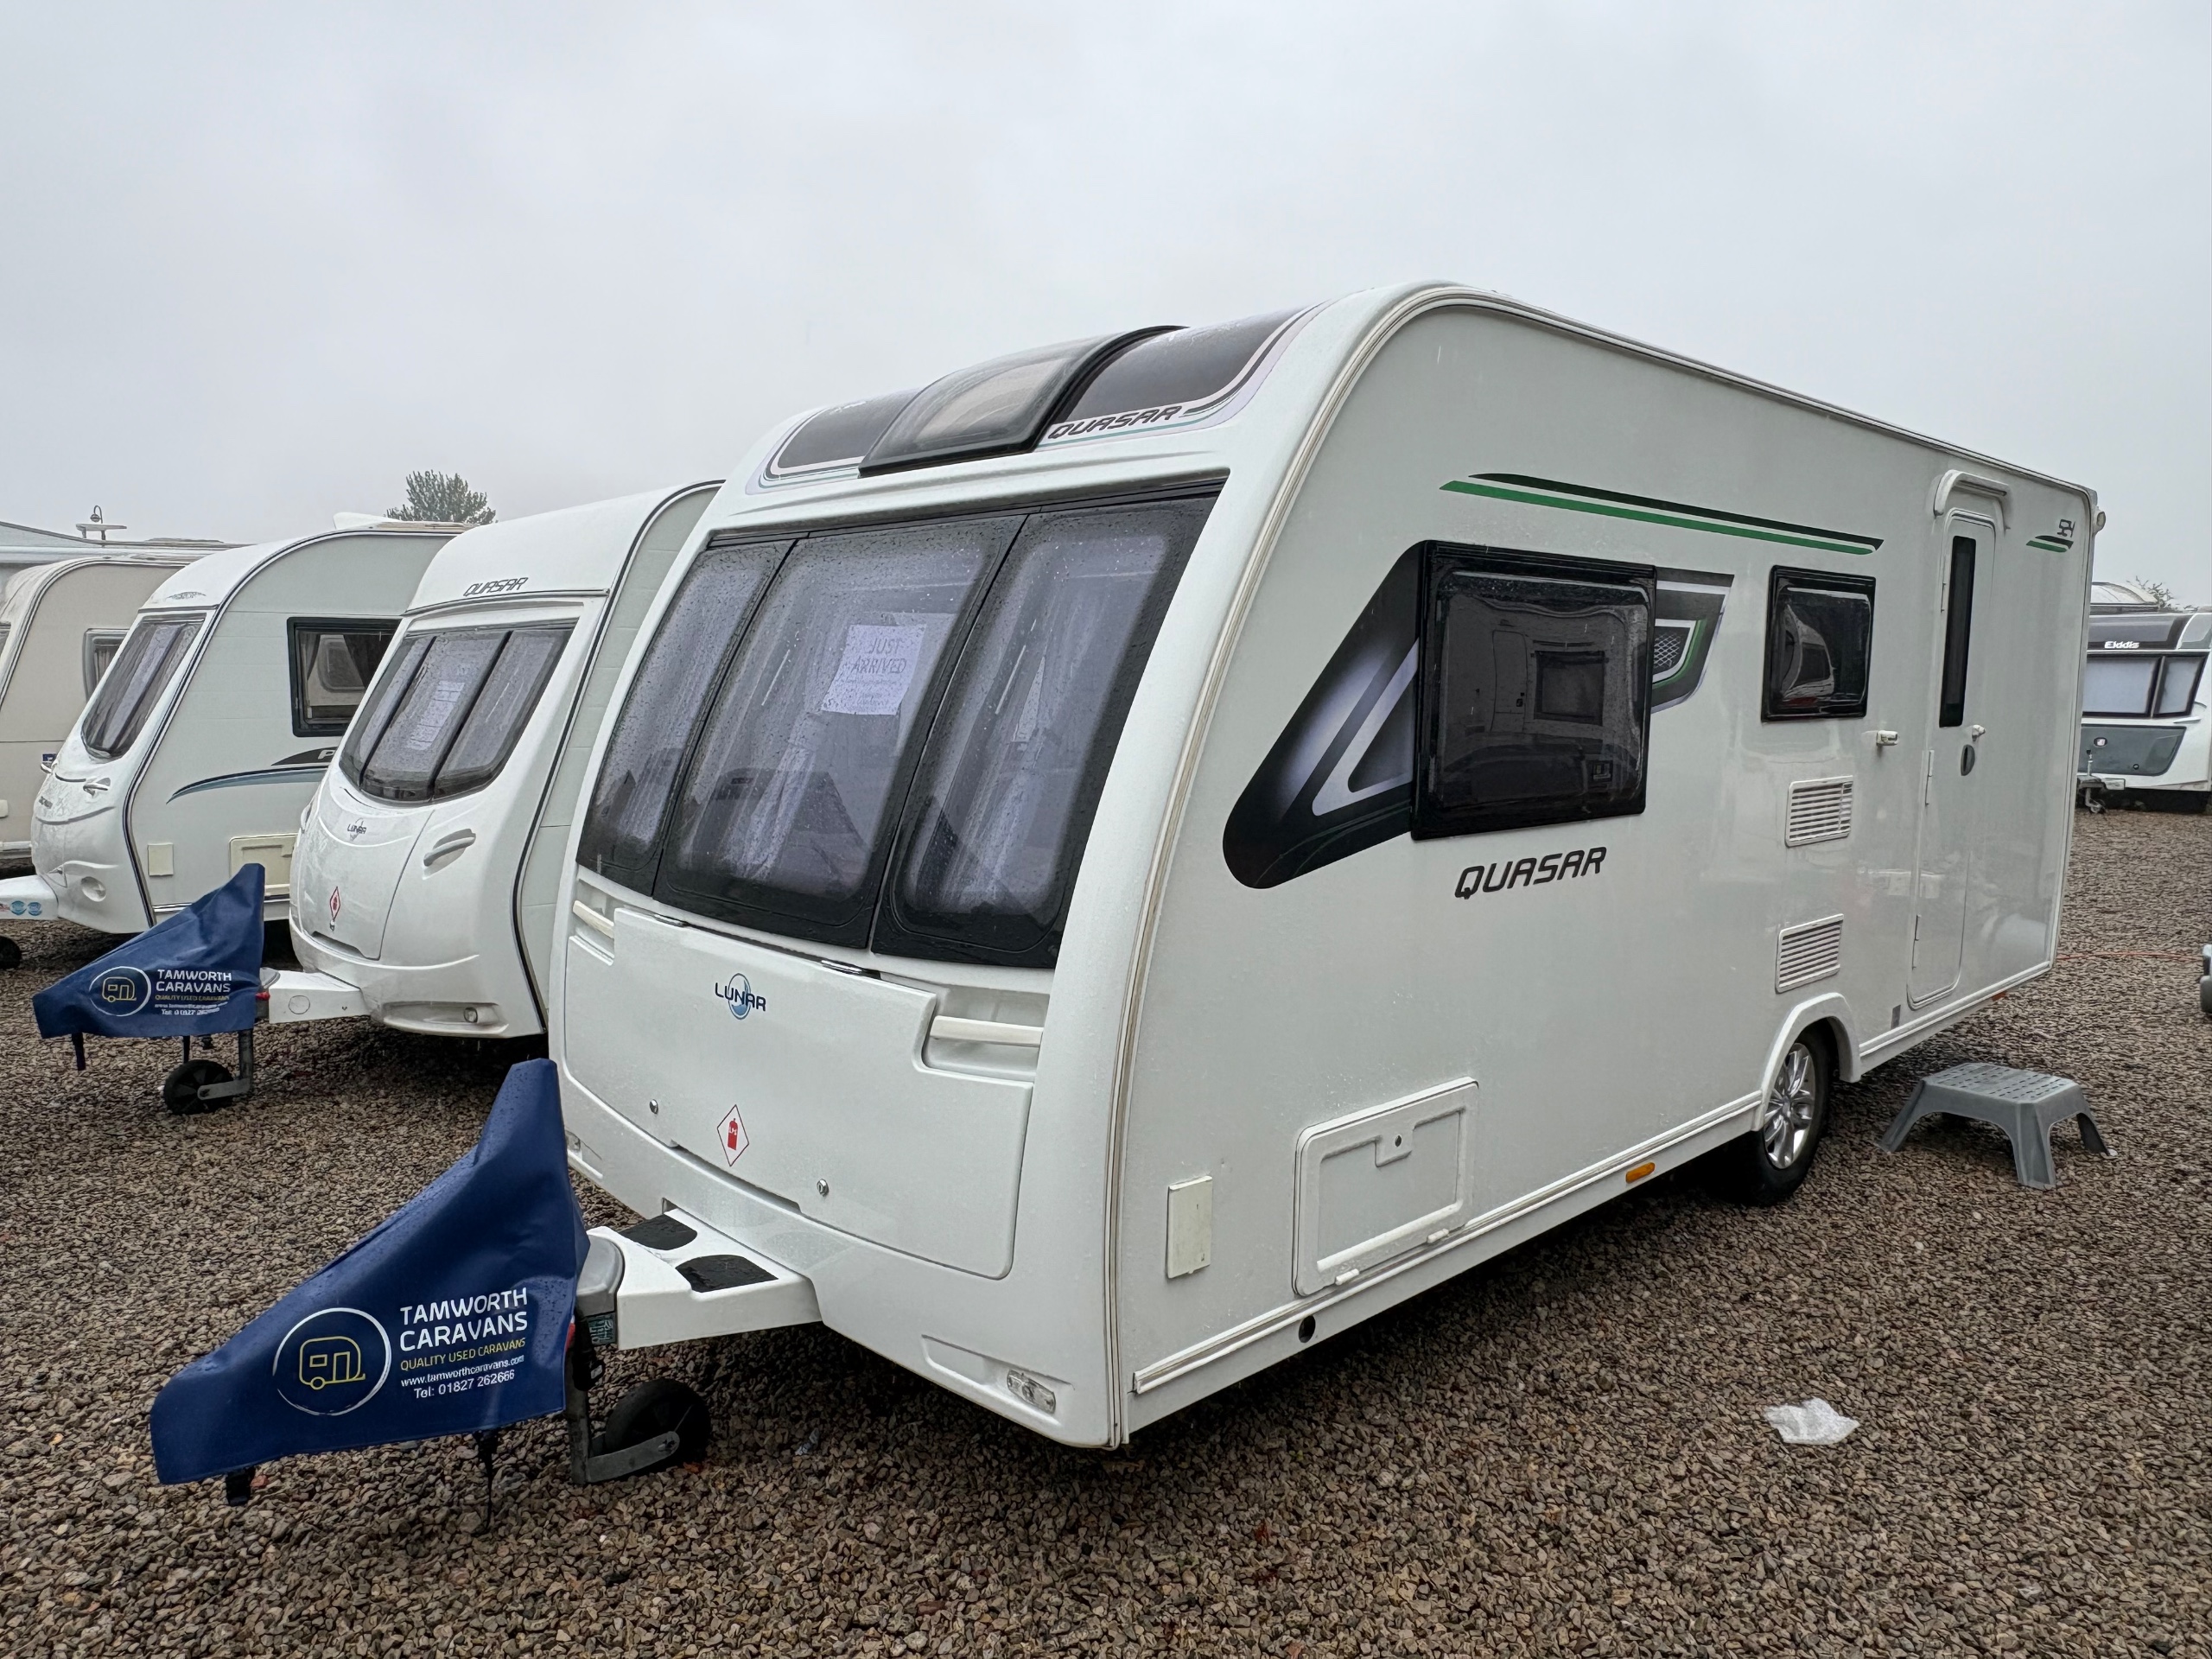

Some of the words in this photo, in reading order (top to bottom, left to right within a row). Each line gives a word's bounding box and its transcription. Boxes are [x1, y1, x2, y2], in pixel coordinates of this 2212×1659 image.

[1047, 405, 1183, 440] QUASAR
[462, 576, 529, 597] QUASAR
[866, 638, 902, 655] JUST
[850, 657, 907, 674] ARRIVED
[1454, 846, 1607, 900] QUASAR
[156, 981, 232, 993] CARAVANS
[157, 969, 232, 982] TAMWORTH
[715, 982, 766, 1012] LUNAR
[400, 1287, 528, 1325] TAMWORTH
[400, 1311, 528, 1352] CARAVANS
[400, 1353, 447, 1372] QUALITY
[448, 1348, 476, 1363] USED
[478, 1337, 526, 1356] CARAVANS
[400, 1354, 524, 1388] www.tamworthcaravans.com
[414, 1387, 435, 1399] Tel:
[438, 1378, 474, 1395] 01827
[477, 1370, 515, 1388] 262666
